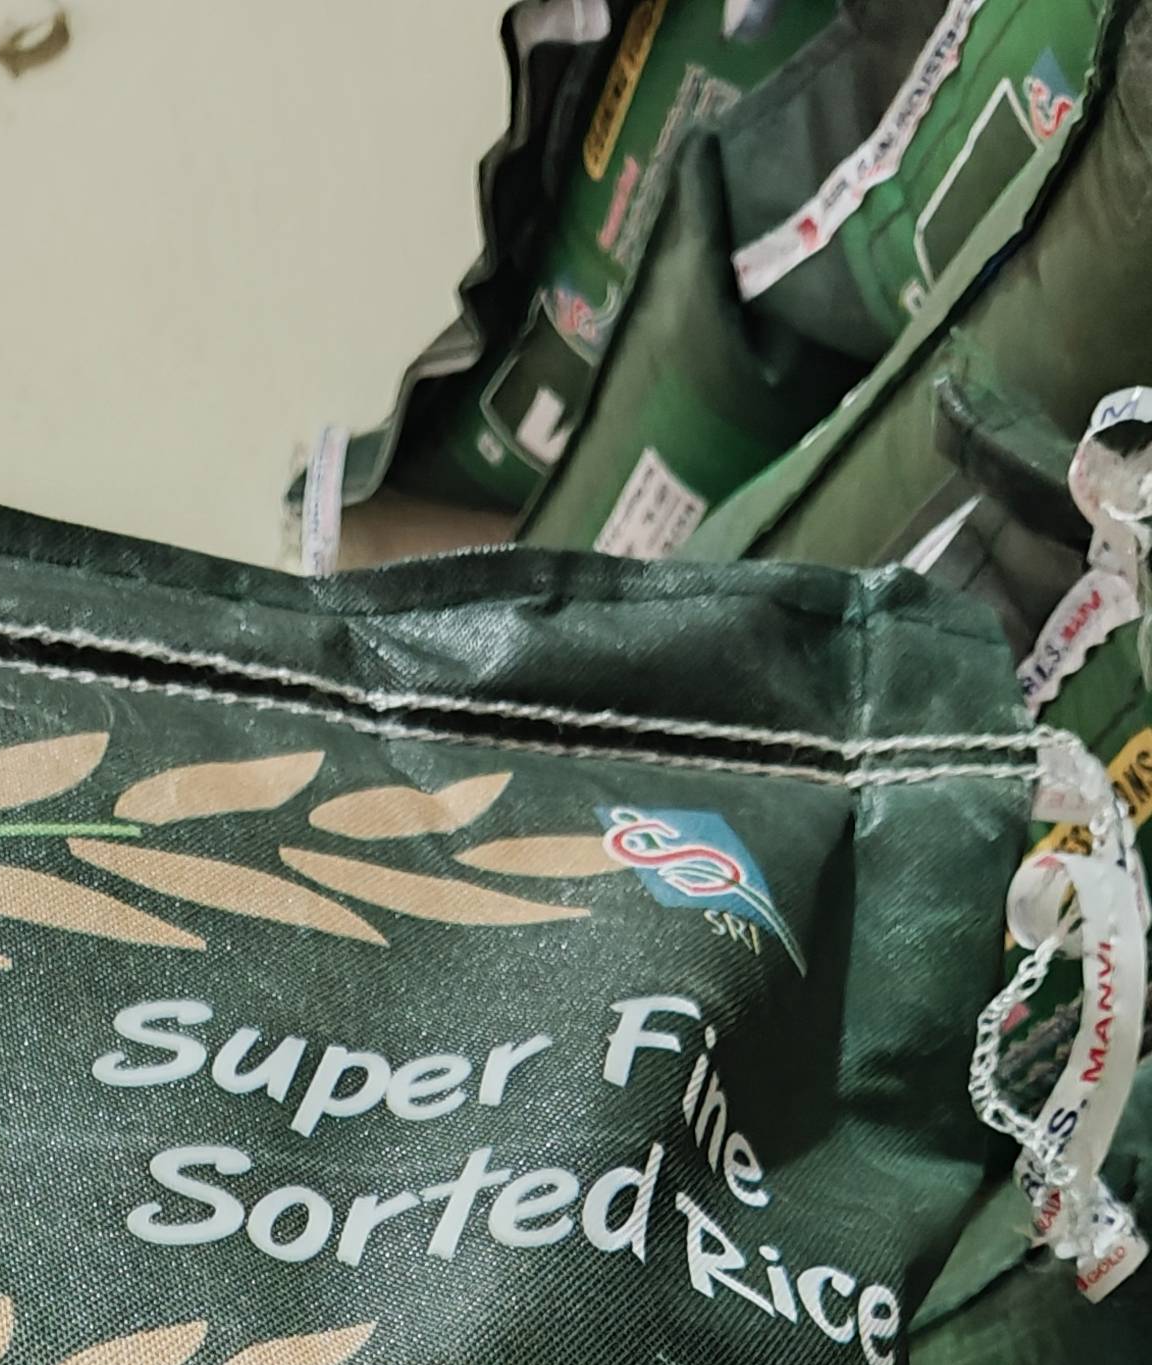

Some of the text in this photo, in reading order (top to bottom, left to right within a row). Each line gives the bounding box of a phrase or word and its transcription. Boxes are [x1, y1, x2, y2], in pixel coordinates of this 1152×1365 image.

[703, 908, 762, 957] SRI
[93, 994, 773, 1212] Super Fine
[125, 1142, 666, 1268] Sorted
